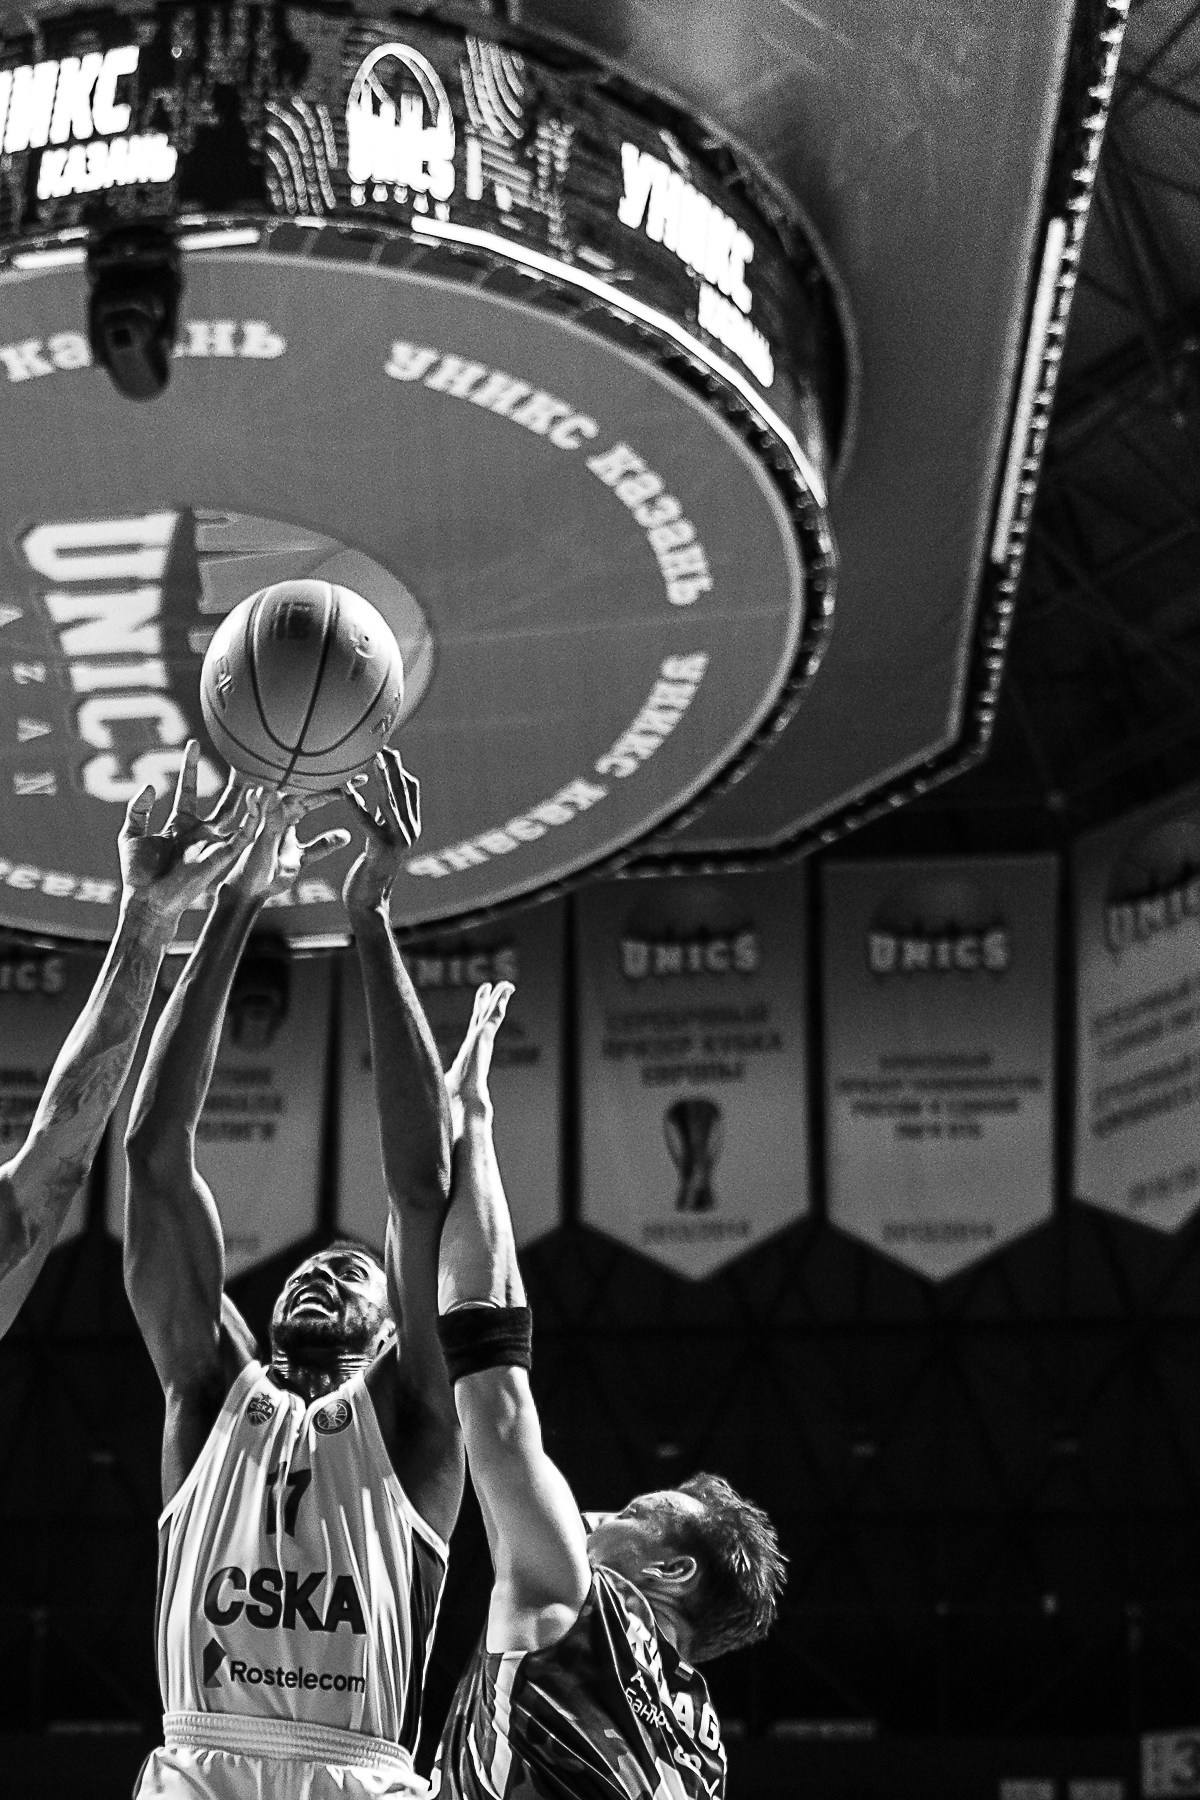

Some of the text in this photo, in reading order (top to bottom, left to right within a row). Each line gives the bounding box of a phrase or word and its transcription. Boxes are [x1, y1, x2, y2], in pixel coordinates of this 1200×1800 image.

[21, 511, 228, 802] UNICS
[403, 946, 518, 988] NICS
[620, 931, 758, 979] UNICS
[867, 929, 1009, 975] UNICS
[203, 1566, 367, 1635] CSKA
[230, 1661, 366, 1693] Rostelecom
